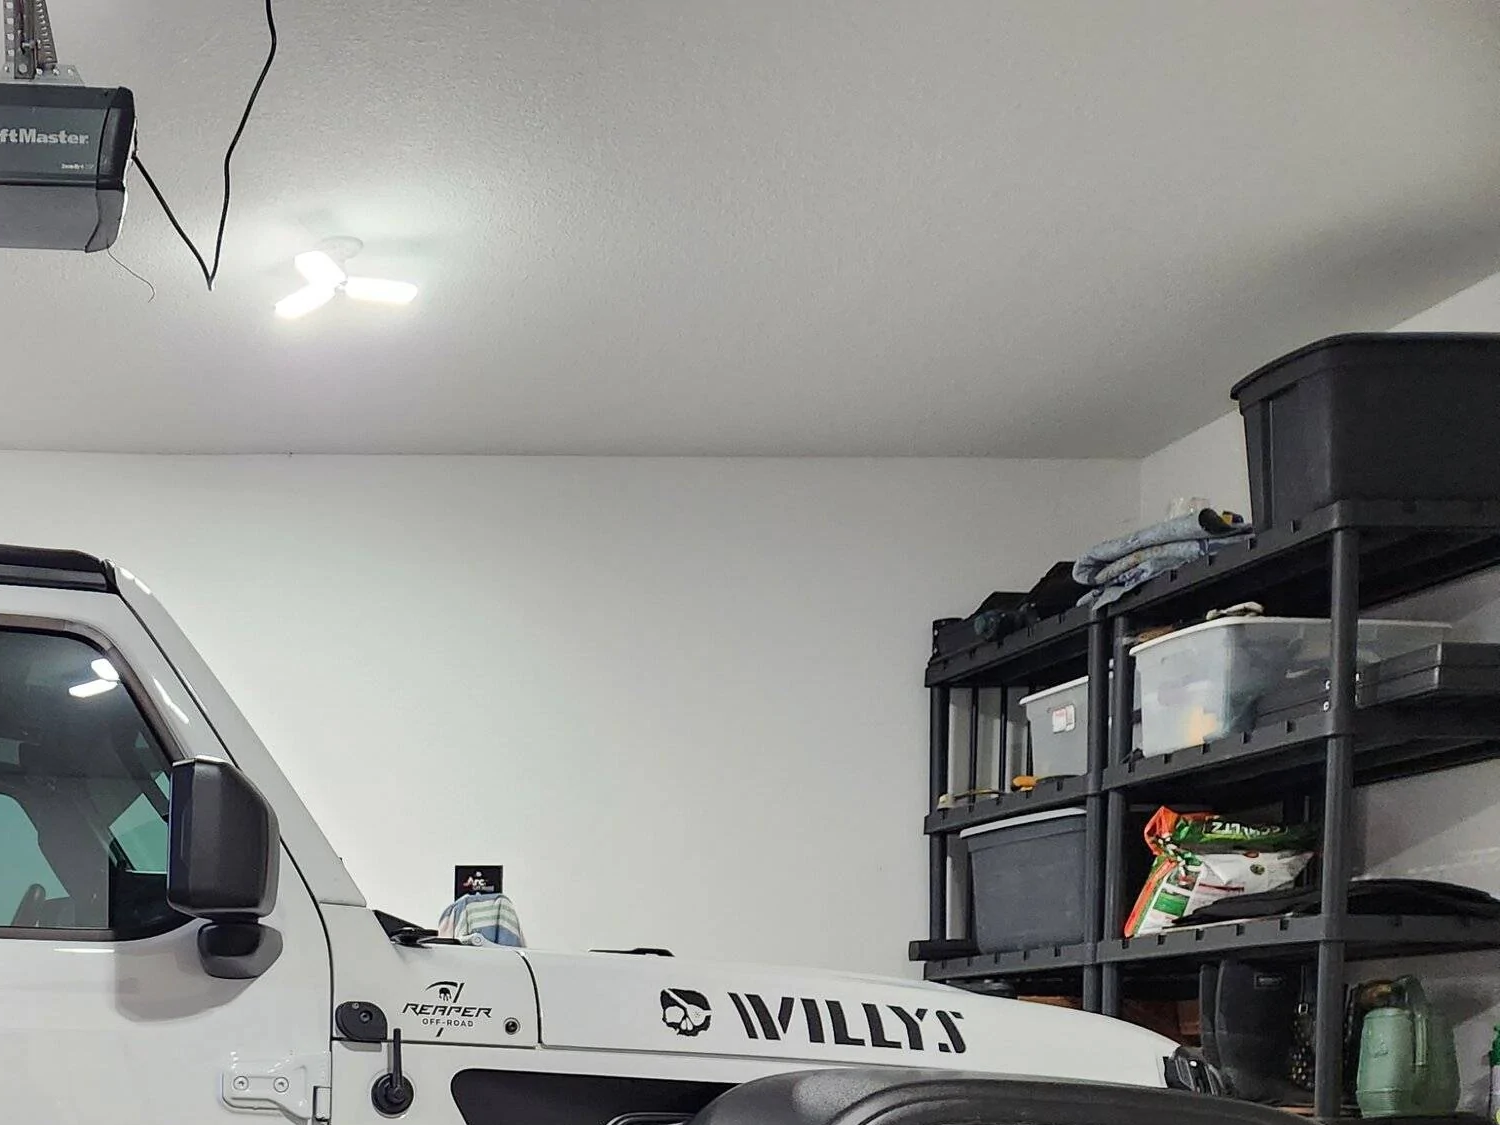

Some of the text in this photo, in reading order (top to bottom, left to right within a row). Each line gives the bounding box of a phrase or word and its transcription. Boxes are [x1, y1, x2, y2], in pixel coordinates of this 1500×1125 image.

[402, 1003, 492, 1019] REAPER
[422, 1018, 474, 1028] OFF-ROAD
[727, 991, 967, 1054] WILLYS
